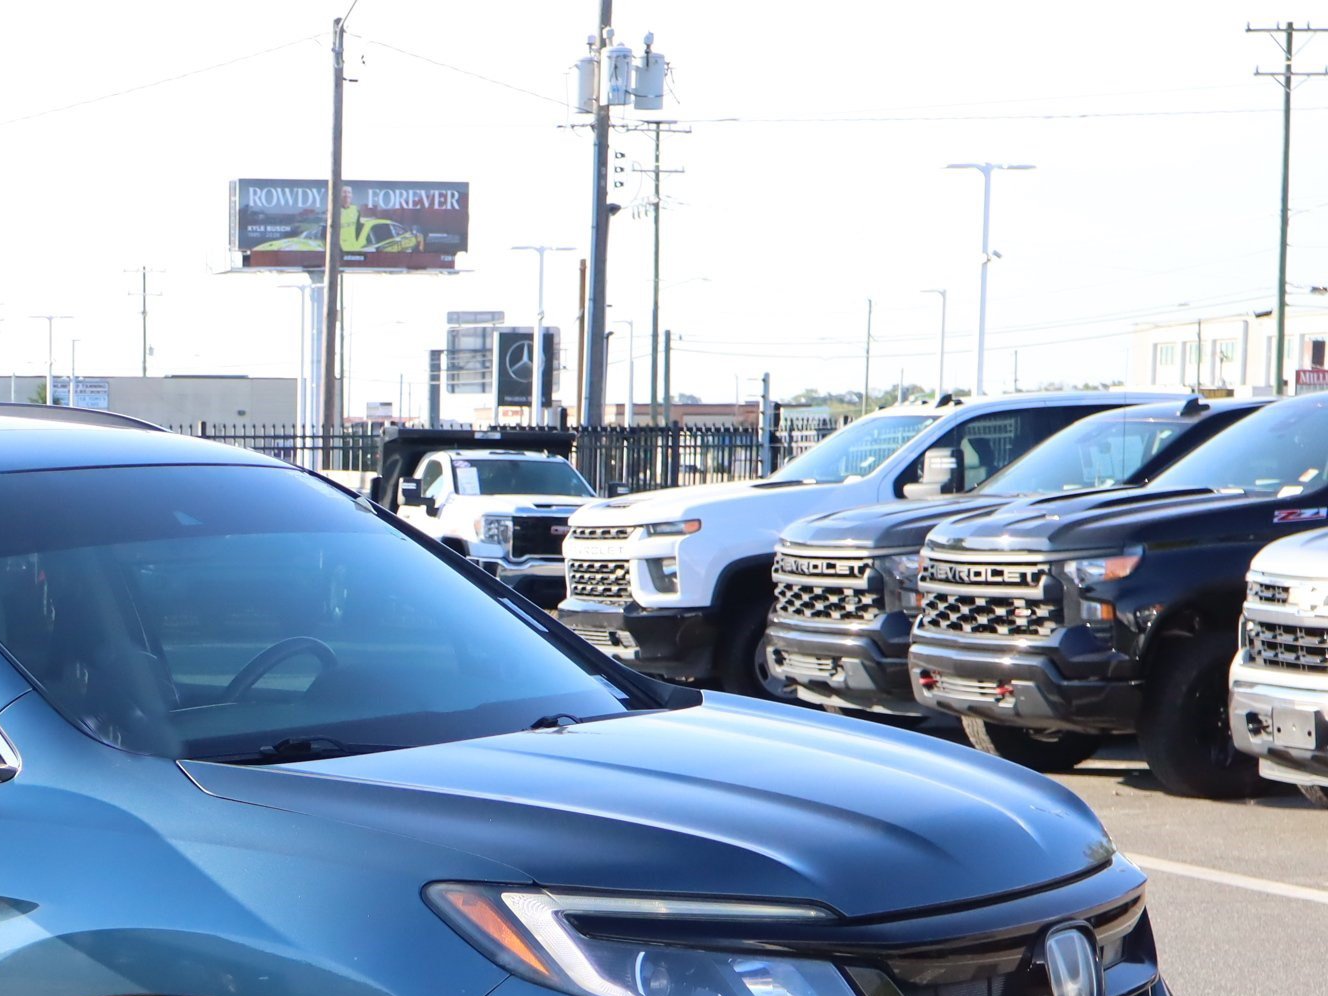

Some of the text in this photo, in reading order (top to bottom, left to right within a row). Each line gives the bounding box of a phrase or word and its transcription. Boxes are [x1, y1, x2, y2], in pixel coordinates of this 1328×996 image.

[248, 187, 460, 209] ROWDY FOREVER
[1298, 371, 1328, 384] MILL
[920, 563, 1040, 584] CHEVROLET
